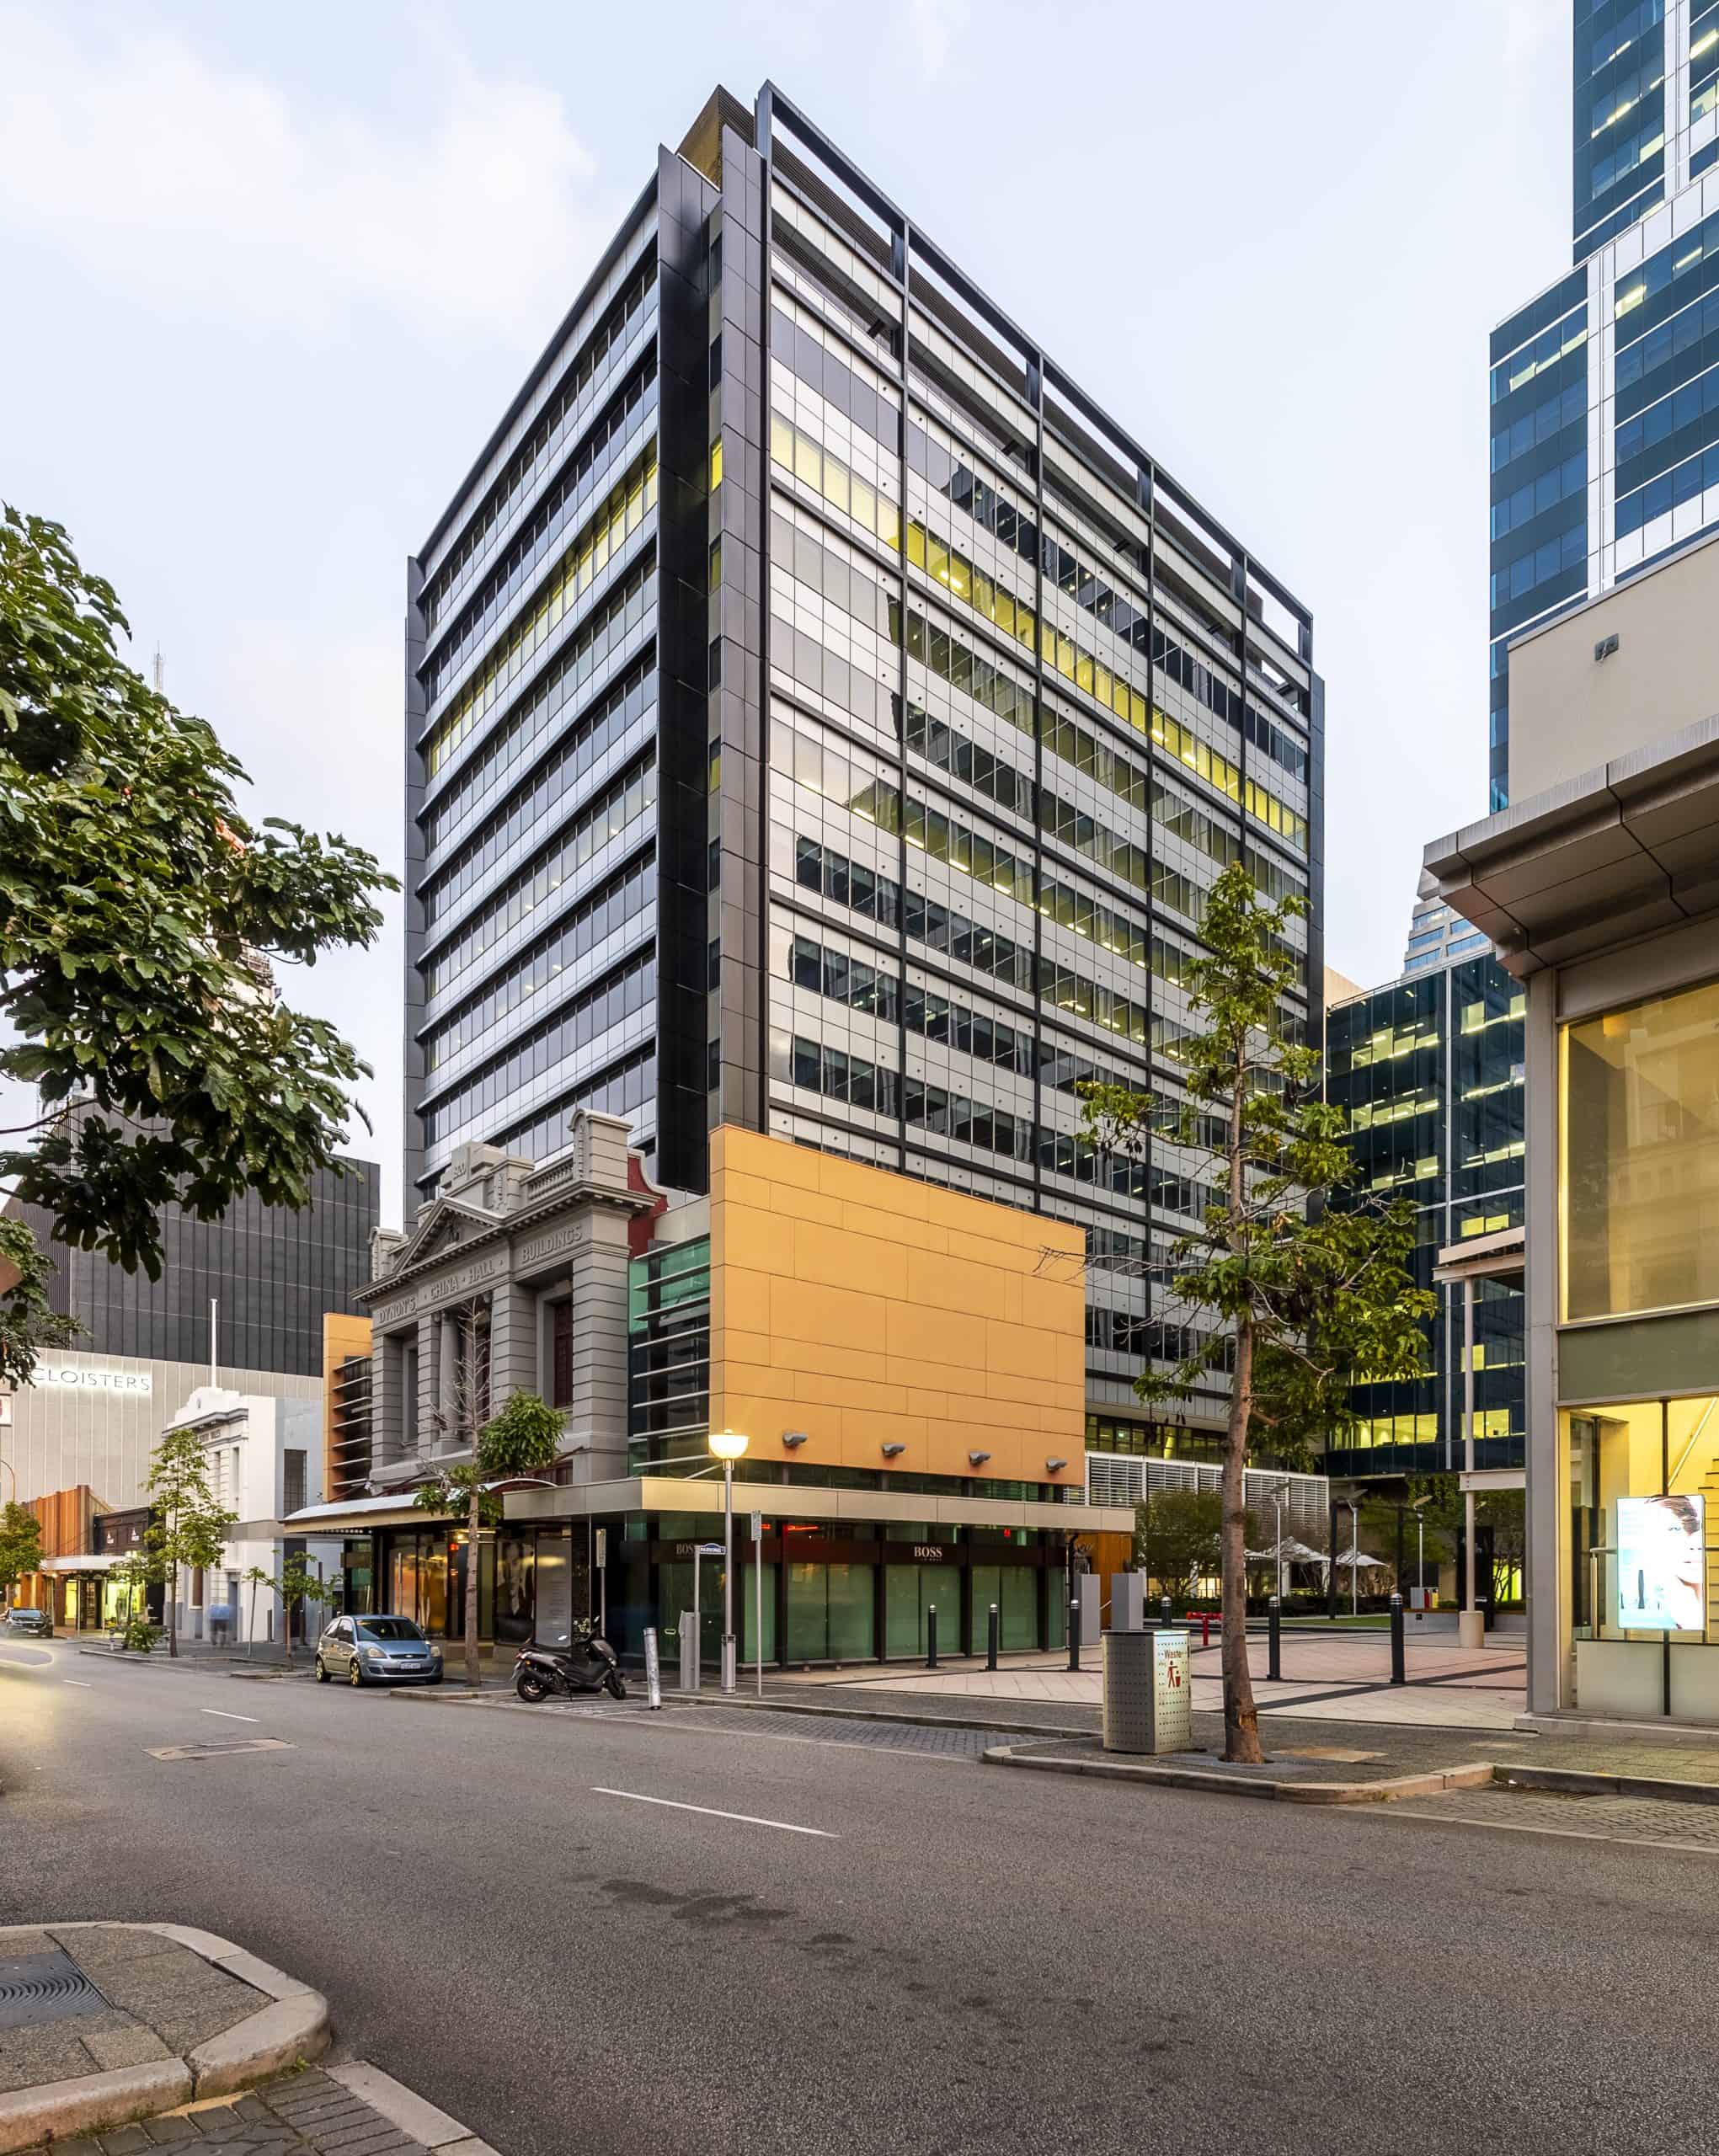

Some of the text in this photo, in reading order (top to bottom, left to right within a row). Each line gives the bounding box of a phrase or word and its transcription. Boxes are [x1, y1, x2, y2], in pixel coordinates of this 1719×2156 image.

[379, 1226, 581, 1324] DYNON'S CHINA HALL BUILDINGS
[30, 1367, 150, 1390] CLOISTERS
[676, 1543, 695, 1556] BOS
[914, 1545, 942, 1558] BOSS
